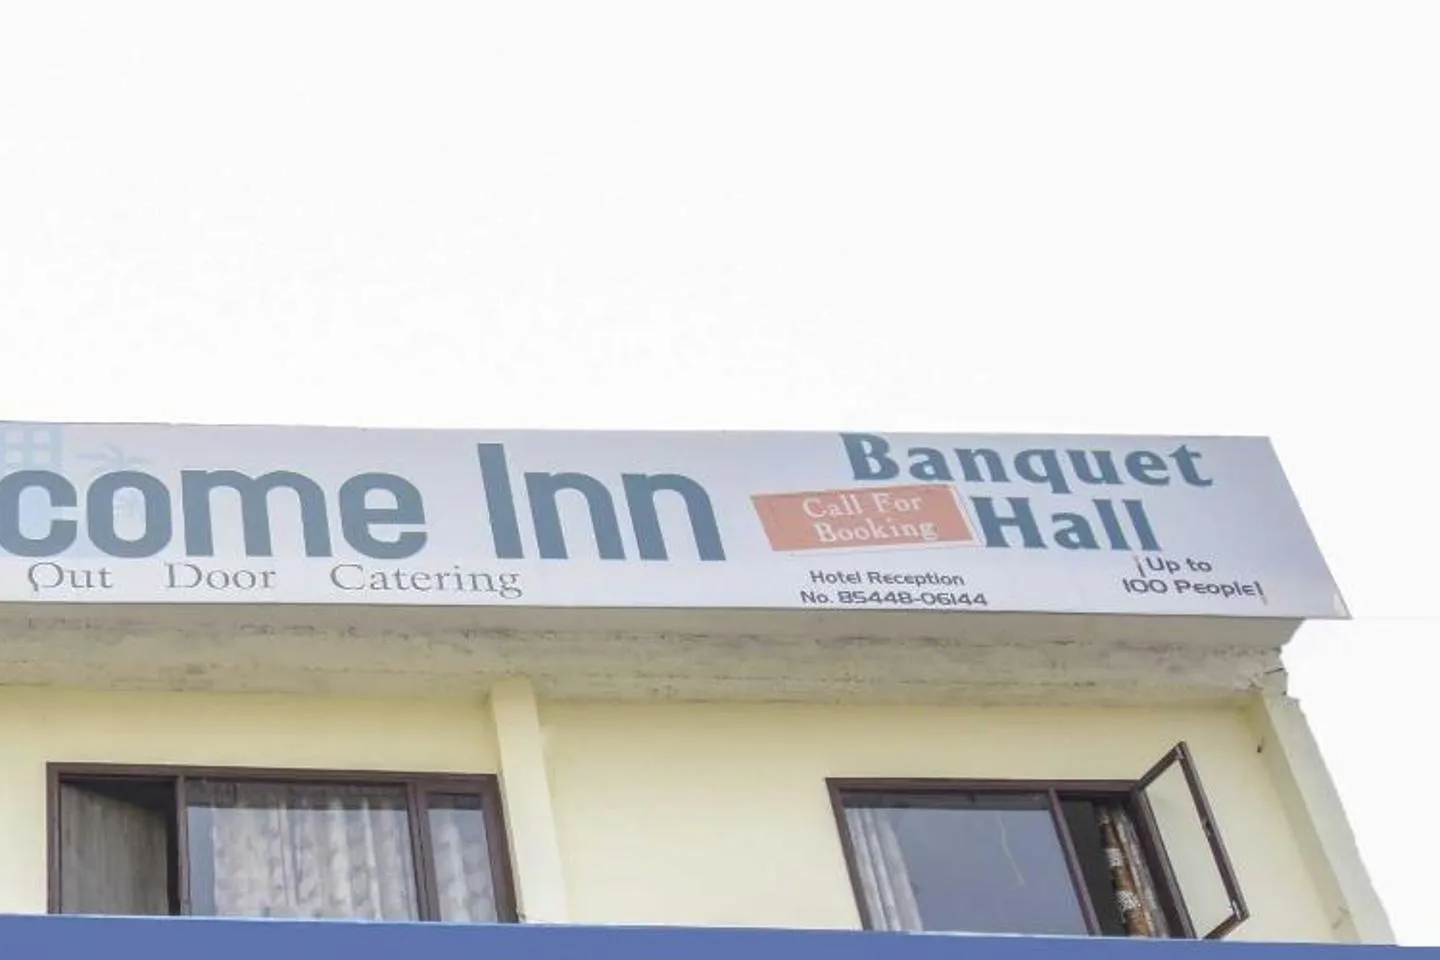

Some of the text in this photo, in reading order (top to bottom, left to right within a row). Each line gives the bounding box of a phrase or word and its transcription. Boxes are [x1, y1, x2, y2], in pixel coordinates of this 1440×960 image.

[840, 433, 1213, 494] Banquet
[477, 442, 726, 561] Inn
[802, 492, 923, 518] Call For
[813, 517, 938, 541] Booking
[969, 497, 1162, 551] Hall
[1185, 558, 1213, 573] to
[27, 561, 113, 592] Out
[163, 563, 278, 590] Door
[330, 562, 524, 599] Catering
[810, 570, 965, 587] Hotel Reception
[1122, 578, 1168, 594] 100
[800, 590, 988, 606] No. 85448-06144
